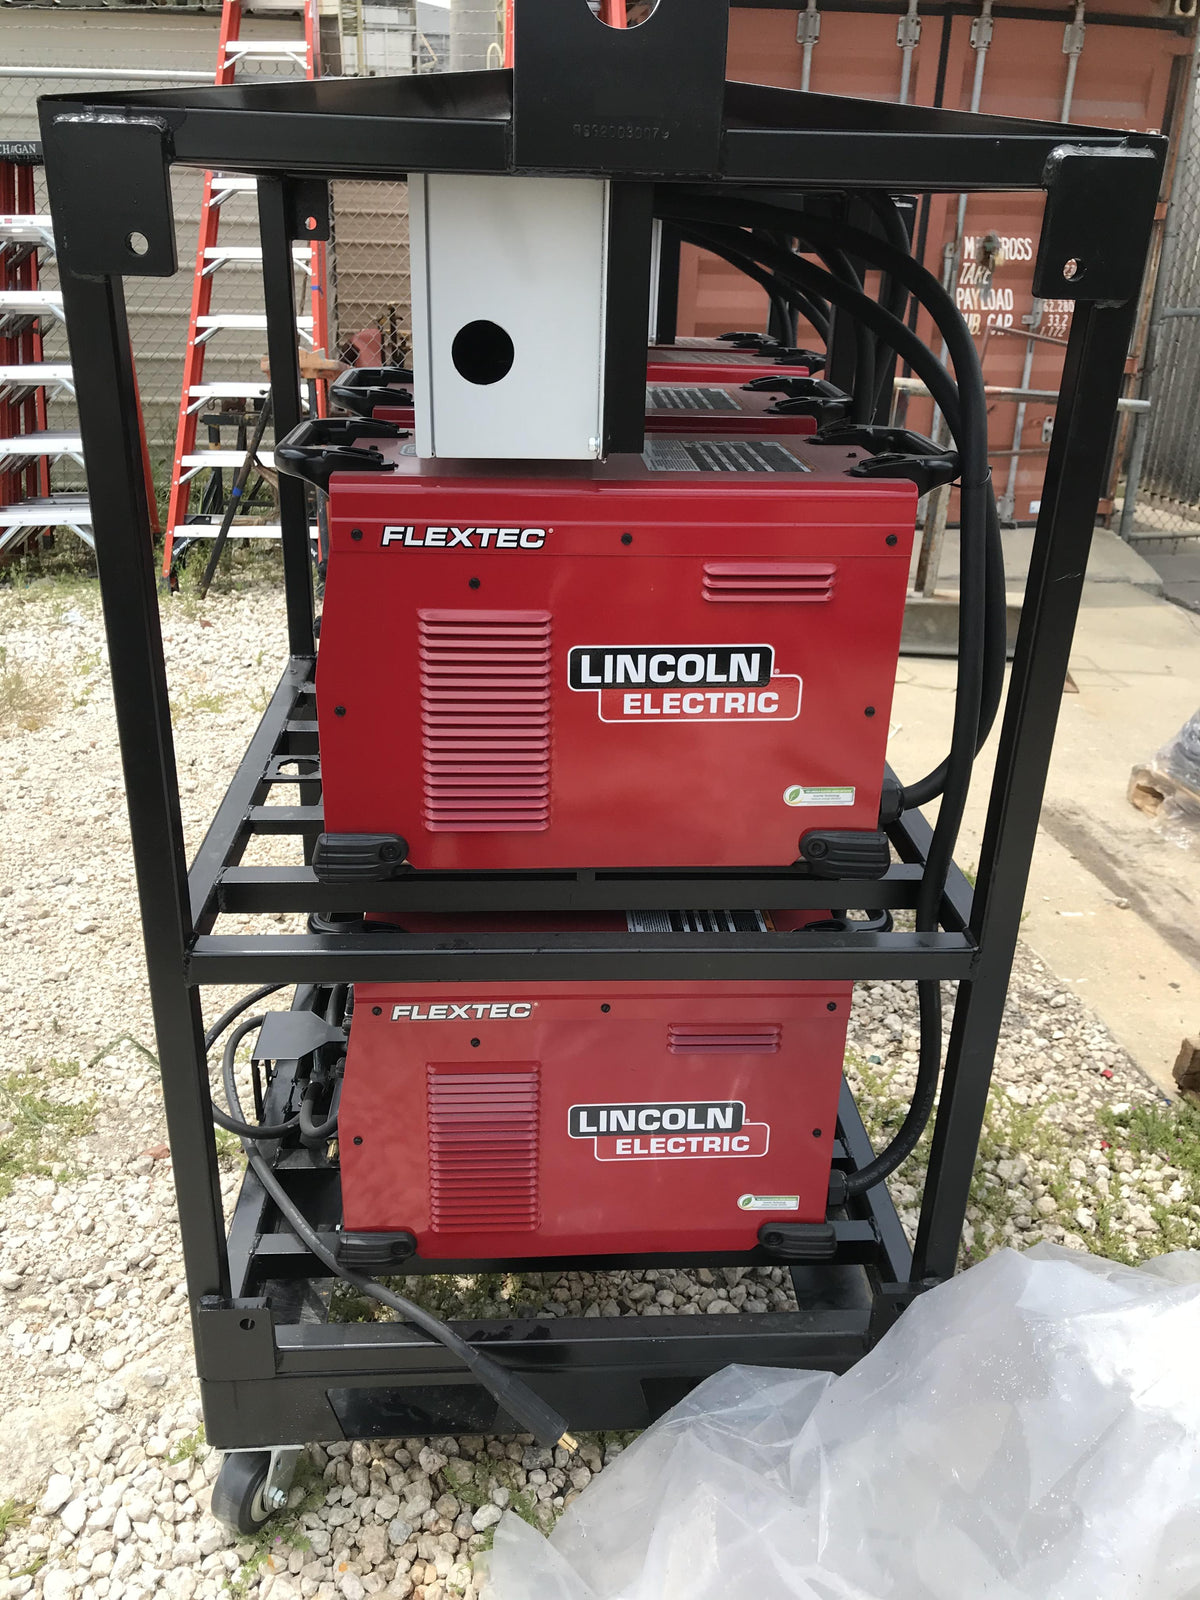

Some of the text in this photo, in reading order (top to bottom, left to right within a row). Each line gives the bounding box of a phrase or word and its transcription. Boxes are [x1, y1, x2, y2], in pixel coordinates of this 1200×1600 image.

[956, 287, 1014, 311] PAYLOAD
[381, 525, 547, 549] FLEXTEC
[580, 653, 761, 684] LINCOLN
[623, 691, 779, 715] ELECTRIC
[391, 1002, 533, 1020] FLEXTEC
[579, 1107, 734, 1133] LINCOLN
[616, 1135, 750, 1155] ELECTRIC
